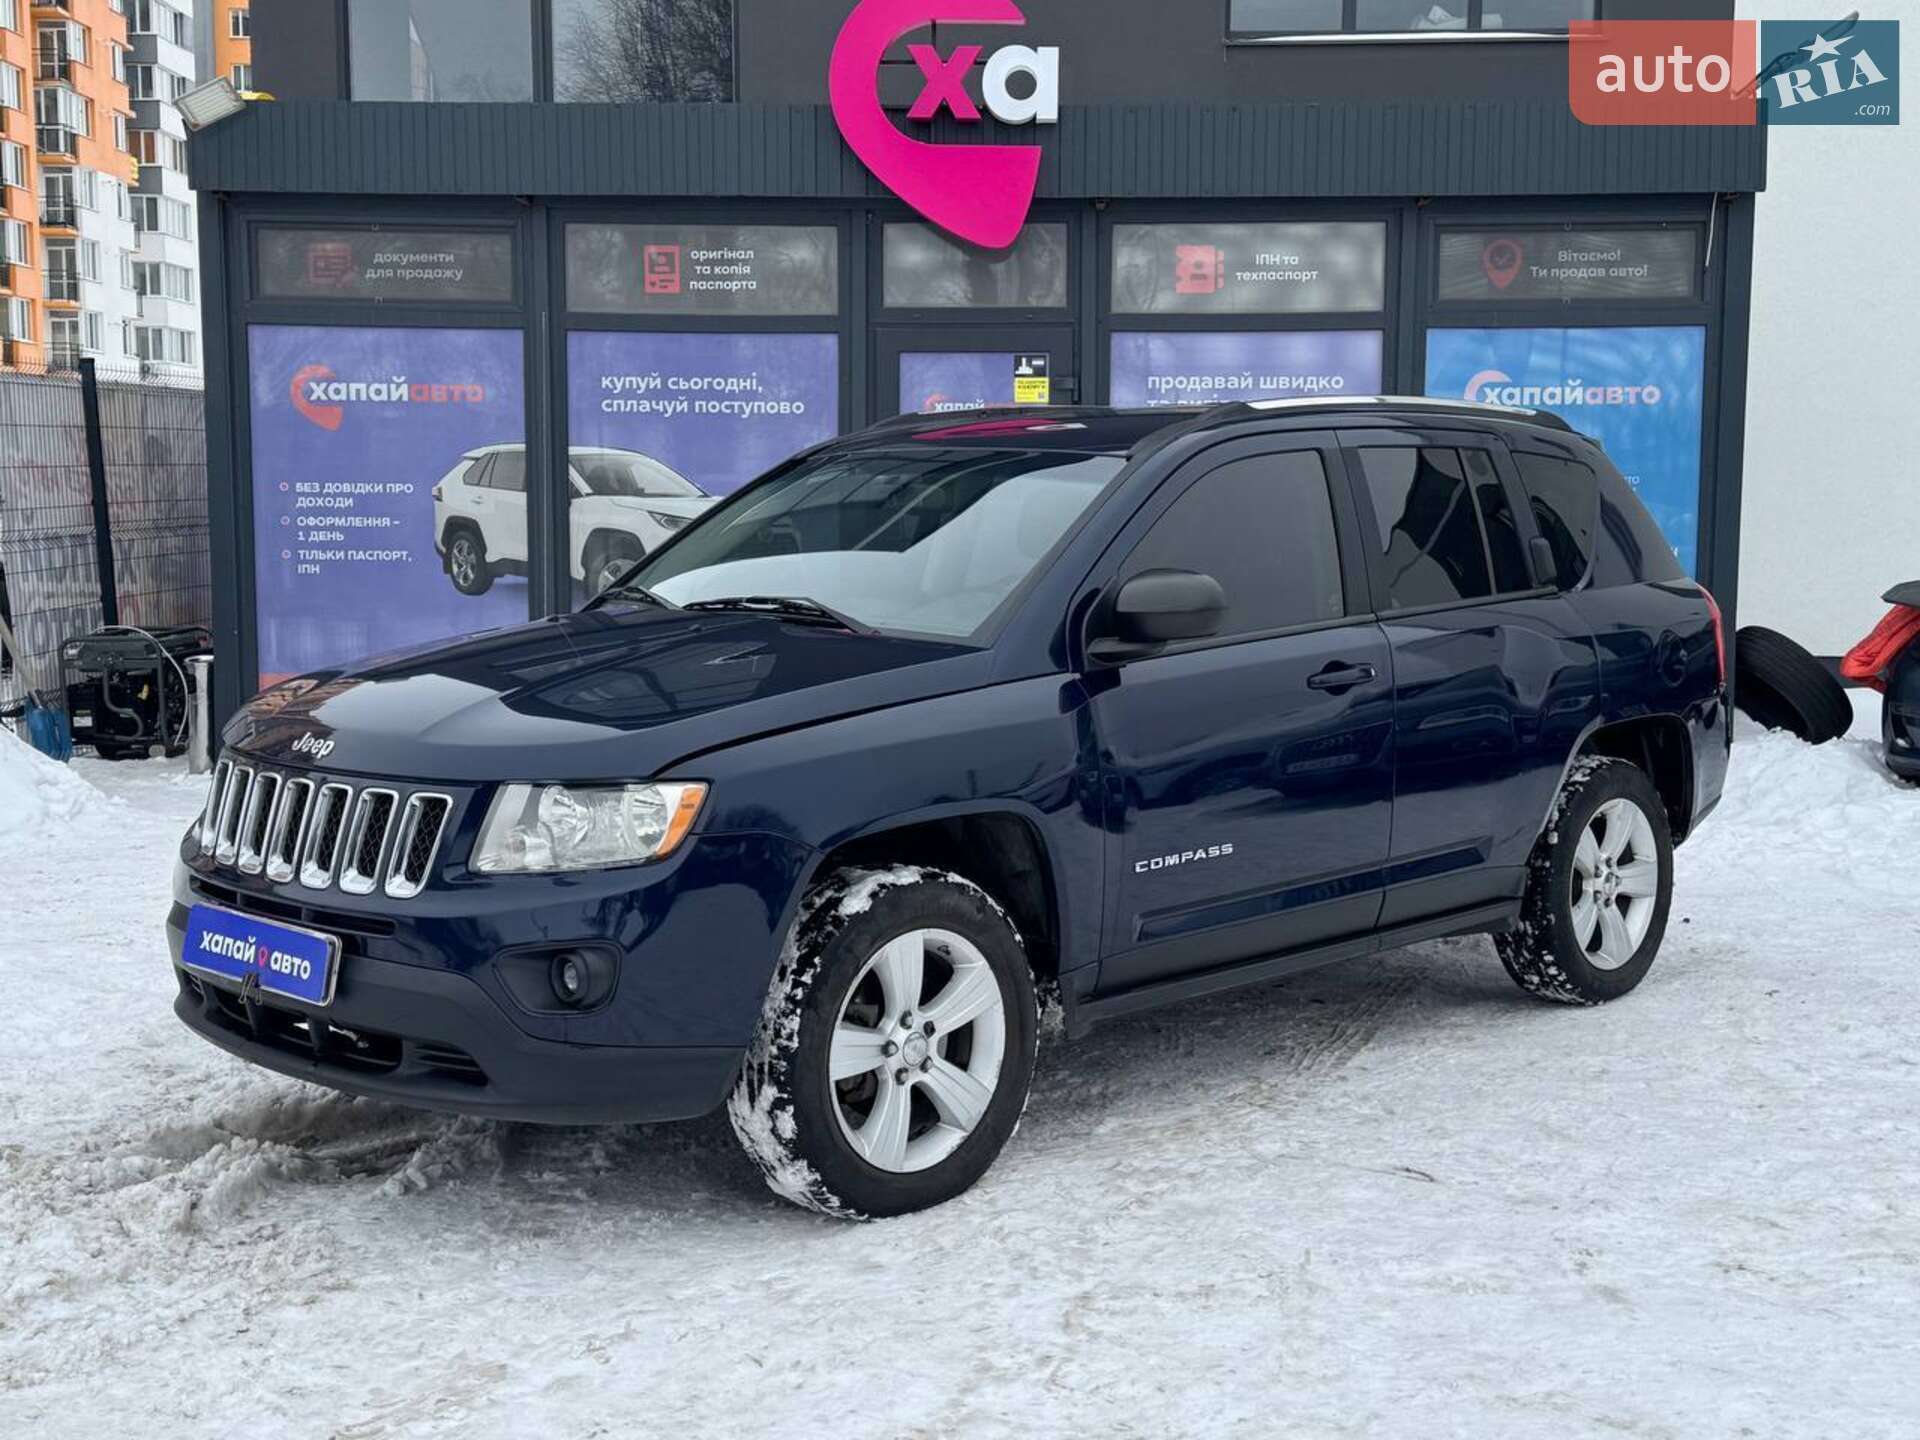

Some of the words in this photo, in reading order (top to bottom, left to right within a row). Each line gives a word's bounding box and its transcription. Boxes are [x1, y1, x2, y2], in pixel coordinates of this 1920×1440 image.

[373, 252, 455, 266] документи
[690, 247, 755, 262] оригінал
[1255, 253, 1281, 266] ІПН
[1283, 255, 1299, 266] та
[1558, 250, 1622, 263] Вітаємо!
[365, 268, 394, 280] для
[695, 265, 711, 275] та
[714, 263, 751, 275] копія
[1236, 269, 1318, 283] техпаспорт
[1530, 266, 1549, 278] Ти
[1551, 266, 1605, 280] продав
[1609, 264, 1648, 278] авто!
[689, 280, 757, 293] паспорта
[601, 372, 661, 394] купуй
[668, 372, 763, 394] сьогодні,
[1147, 371, 1253, 394] продавай
[1259, 375, 1344, 393] швидко
[601, 397, 689, 418] сплачуй
[695, 400, 805, 418] поступово
[296, 482, 320, 493] БЕЗ
[323, 482, 383, 495] ДОВІДКИ
[387, 482, 414, 494] ПРО
[296, 496, 354, 509] ДОХОДИ
[297, 516, 390, 528] ОФОРМЛЕННЯ
[298, 531, 305, 541] 1
[308, 530, 344, 544] ДЕНЬ
[298, 549, 345, 562] ТІЛЬКИ
[348, 550, 413, 563] ПАСПОРТ,
[297, 563, 320, 575] ІПН
[292, 732, 335, 759] Jeep
[1134, 843, 1234, 873] COMPASS
[199, 928, 255, 965] хапай
[270, 953, 311, 981] авто
